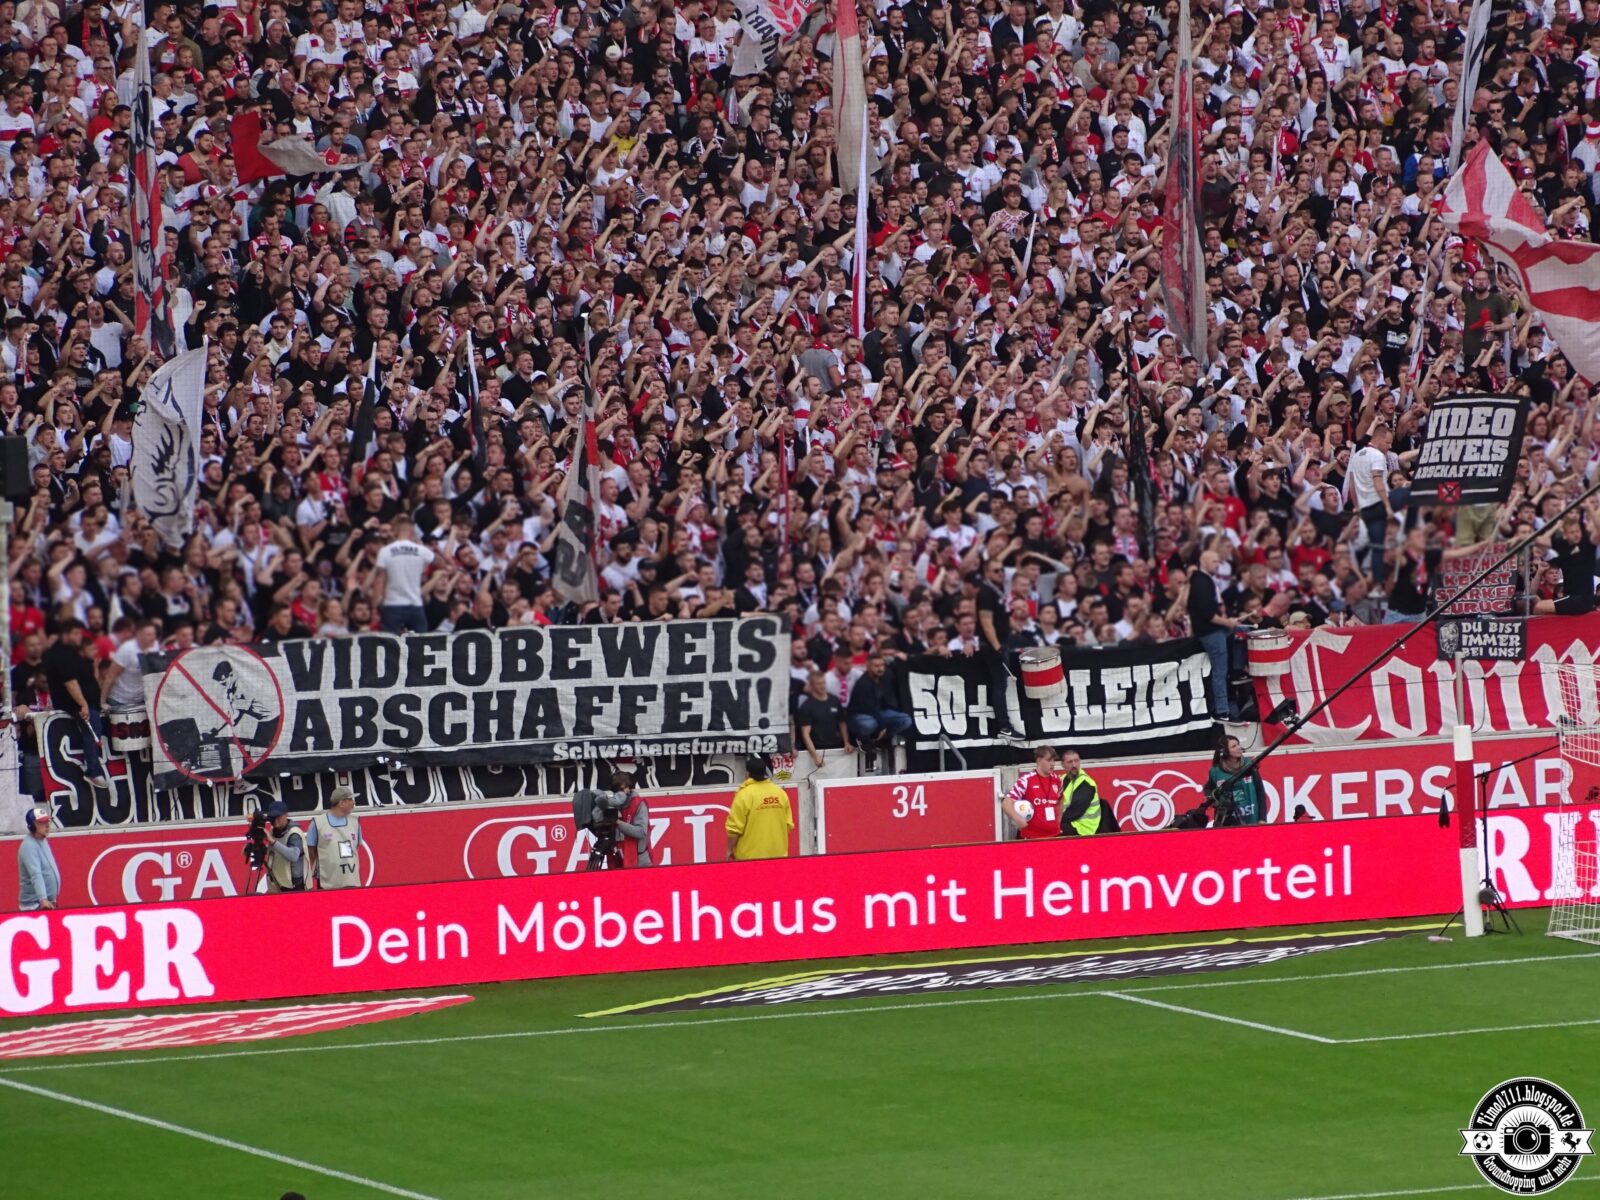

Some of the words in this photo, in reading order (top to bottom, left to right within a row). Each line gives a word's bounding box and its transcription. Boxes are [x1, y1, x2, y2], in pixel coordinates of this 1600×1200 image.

[1427, 406, 1517, 440] VIDEO
[1419, 439, 1510, 465] BEWEIS
[1414, 463, 1504, 480] ABSCHAFFEN!
[1443, 571, 1512, 588] KERT
[1461, 622, 1482, 633] DU
[1489, 622, 1522, 634] BIST
[1461, 634, 1520, 647] IMMER
[283, 617, 777, 692] VIDEOBEWEIS
[1461, 647, 1483, 657] BEI
[1489, 647, 1522, 658] UNS!
[909, 672, 1026, 737] 50+1
[1039, 652, 1211, 733] BLEIBT
[290, 676, 773, 752] ABSCHAFFEN!
[553, 734, 778, 762] Schwabensturm02
[763, 796, 779, 805] SDS
[892, 784, 928, 818] 34
[339, 863, 356, 875] TV
[332, 911, 469, 967] Dein
[497, 890, 836, 955] Möbelhaus
[864, 875, 967, 929] mit
[993, 844, 1352, 920] Heimvorteil
[0, 907, 214, 1012] GER
